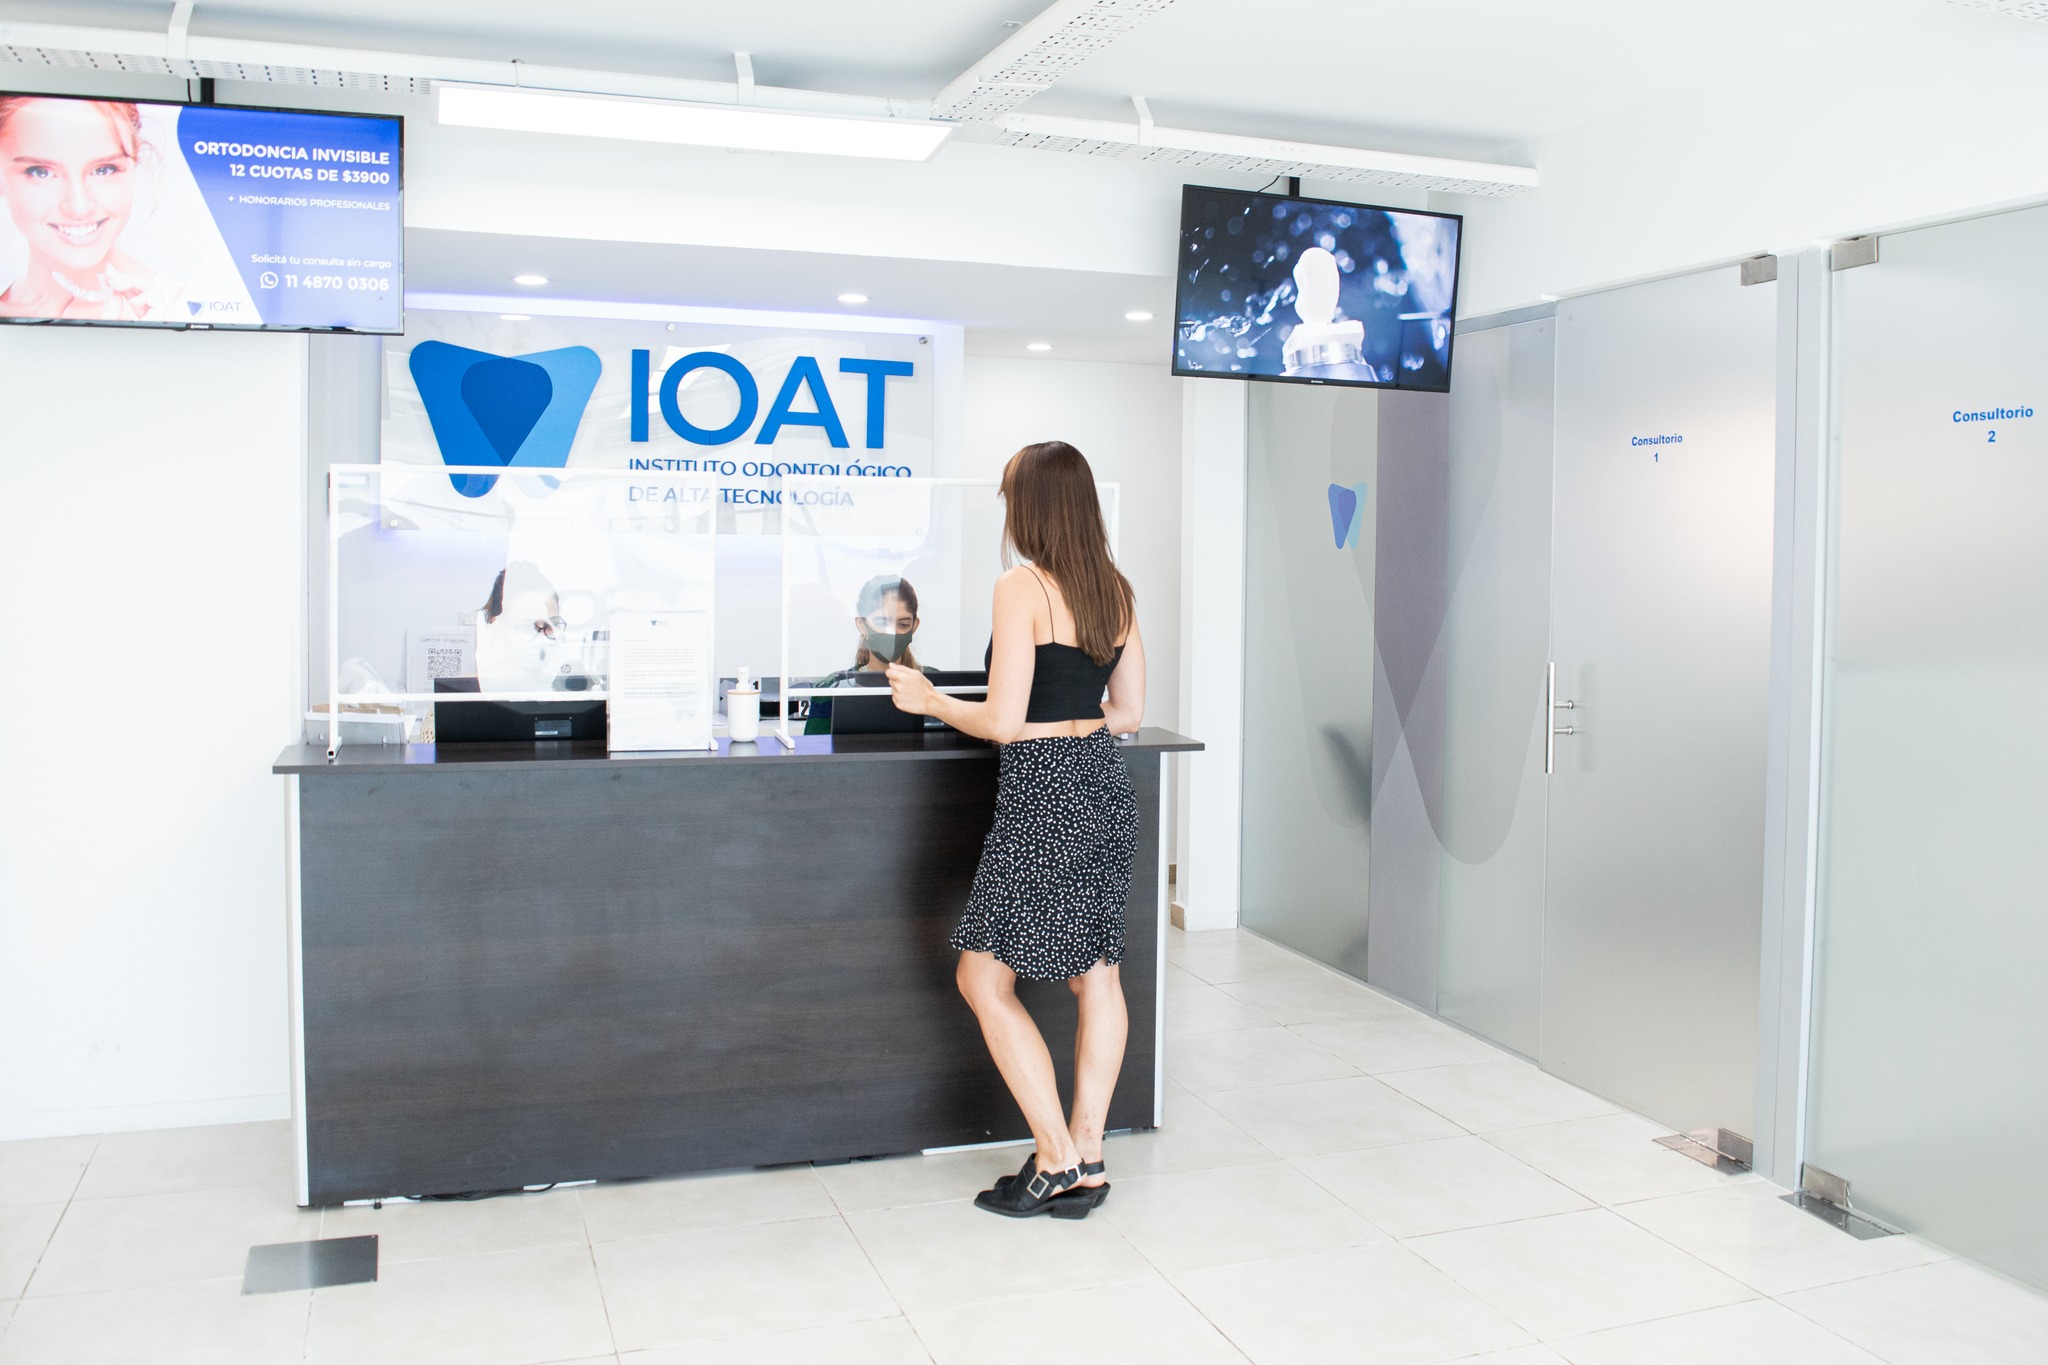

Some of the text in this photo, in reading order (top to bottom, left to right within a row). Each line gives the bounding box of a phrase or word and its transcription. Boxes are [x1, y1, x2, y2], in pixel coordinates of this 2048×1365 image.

[194, 141, 390, 165] ORTODONCIA INVISIBLE
[230, 164, 390, 185] 12 CUOTAS DE $3900
[239, 195, 308, 207] HONORARIOS
[310, 198, 391, 211] PROFESIONALES
[251, 253, 392, 271] Solicitá tu consulta sin cargo
[284, 274, 390, 292] 11 4870 0306
[209, 301, 241, 312] IOAT
[631, 348, 914, 450] IOAT
[1952, 405, 2034, 424] Consultorio
[1631, 433, 1684, 448] Consultorio
[1987, 430, 1996, 443] 2
[628, 458, 737, 476] INSTITUTO
[1653, 453, 1660, 463] 1
[629, 486, 660, 503] DE
